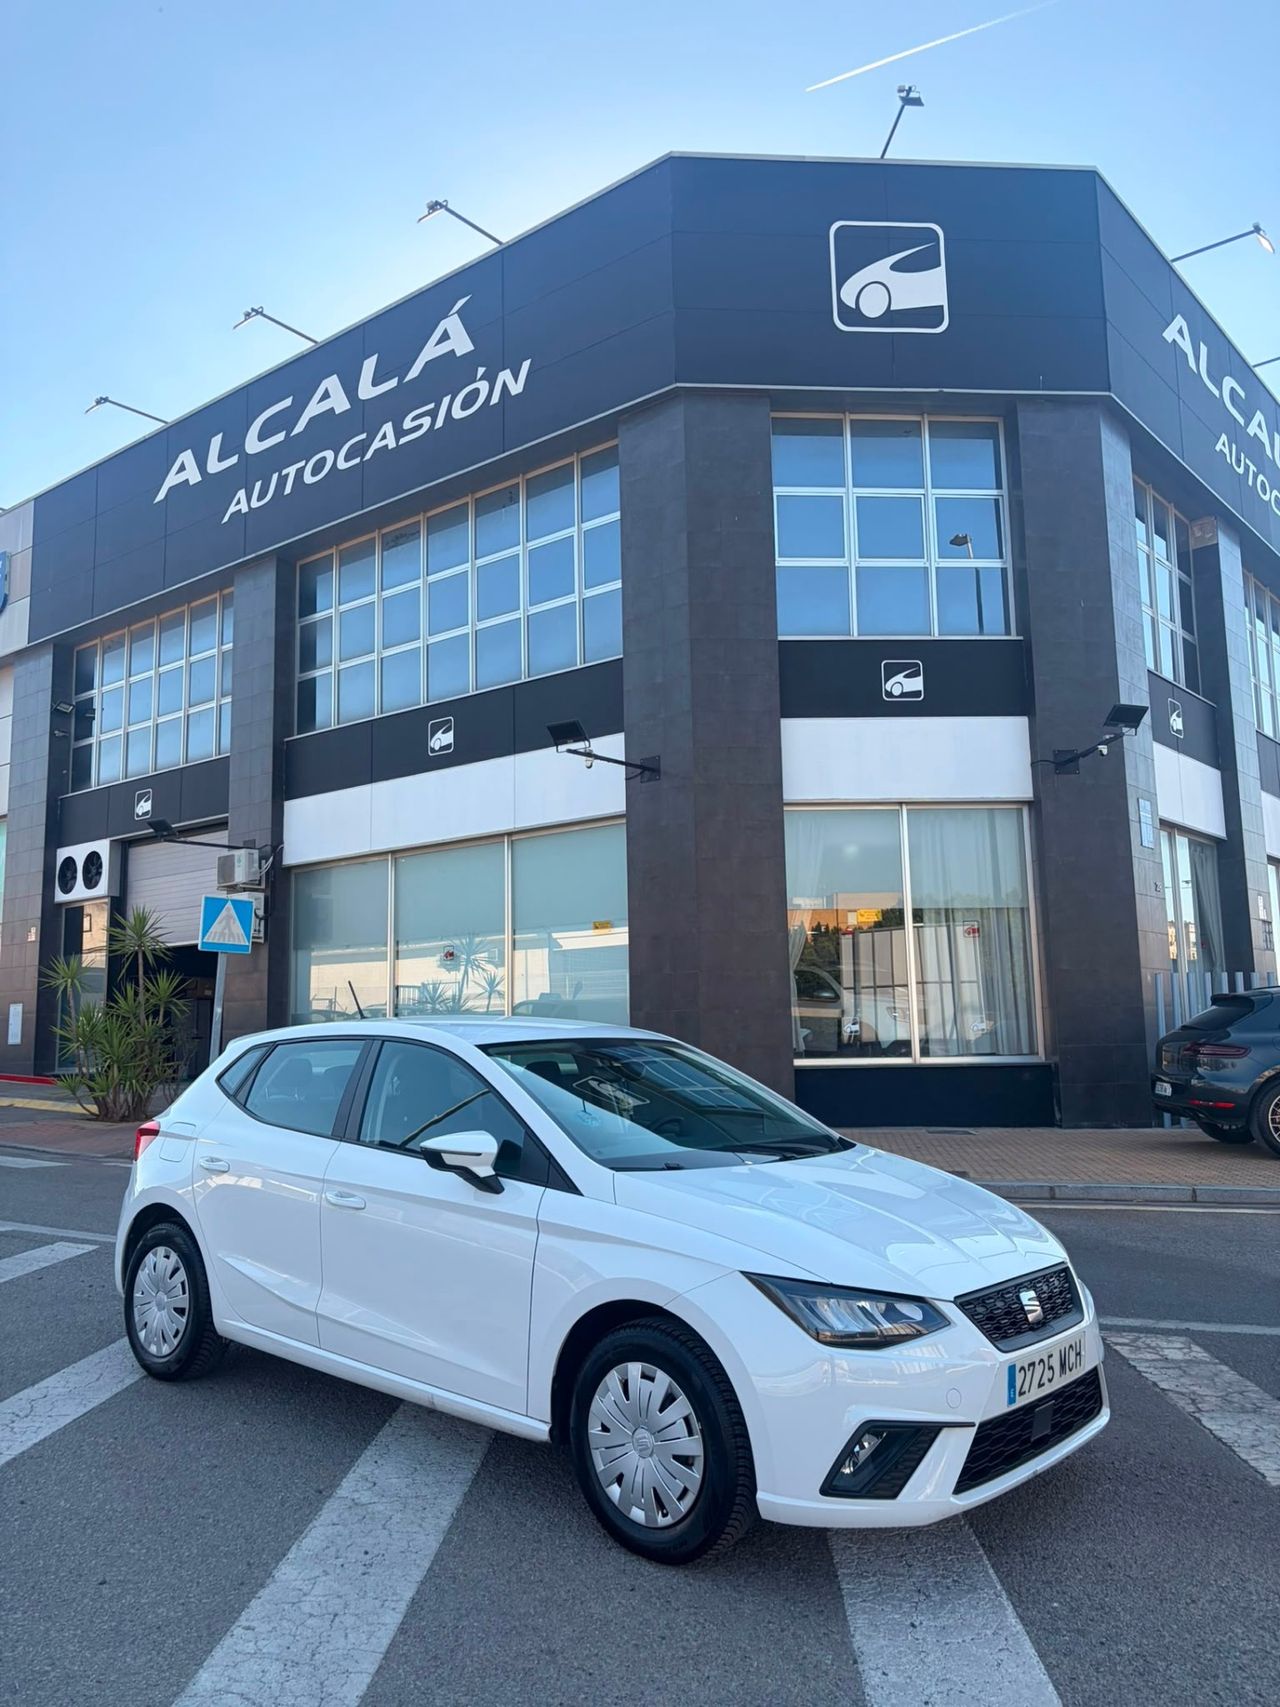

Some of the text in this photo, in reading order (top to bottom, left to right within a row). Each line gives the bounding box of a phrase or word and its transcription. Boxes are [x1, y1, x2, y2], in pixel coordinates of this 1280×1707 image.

[153, 294, 475, 503] ALCALÁ
[221, 358, 532, 524] AUTOCASIÓN
[1018, 1353, 1055, 1397] 2725
[1059, 1339, 1082, 1377] MCH
